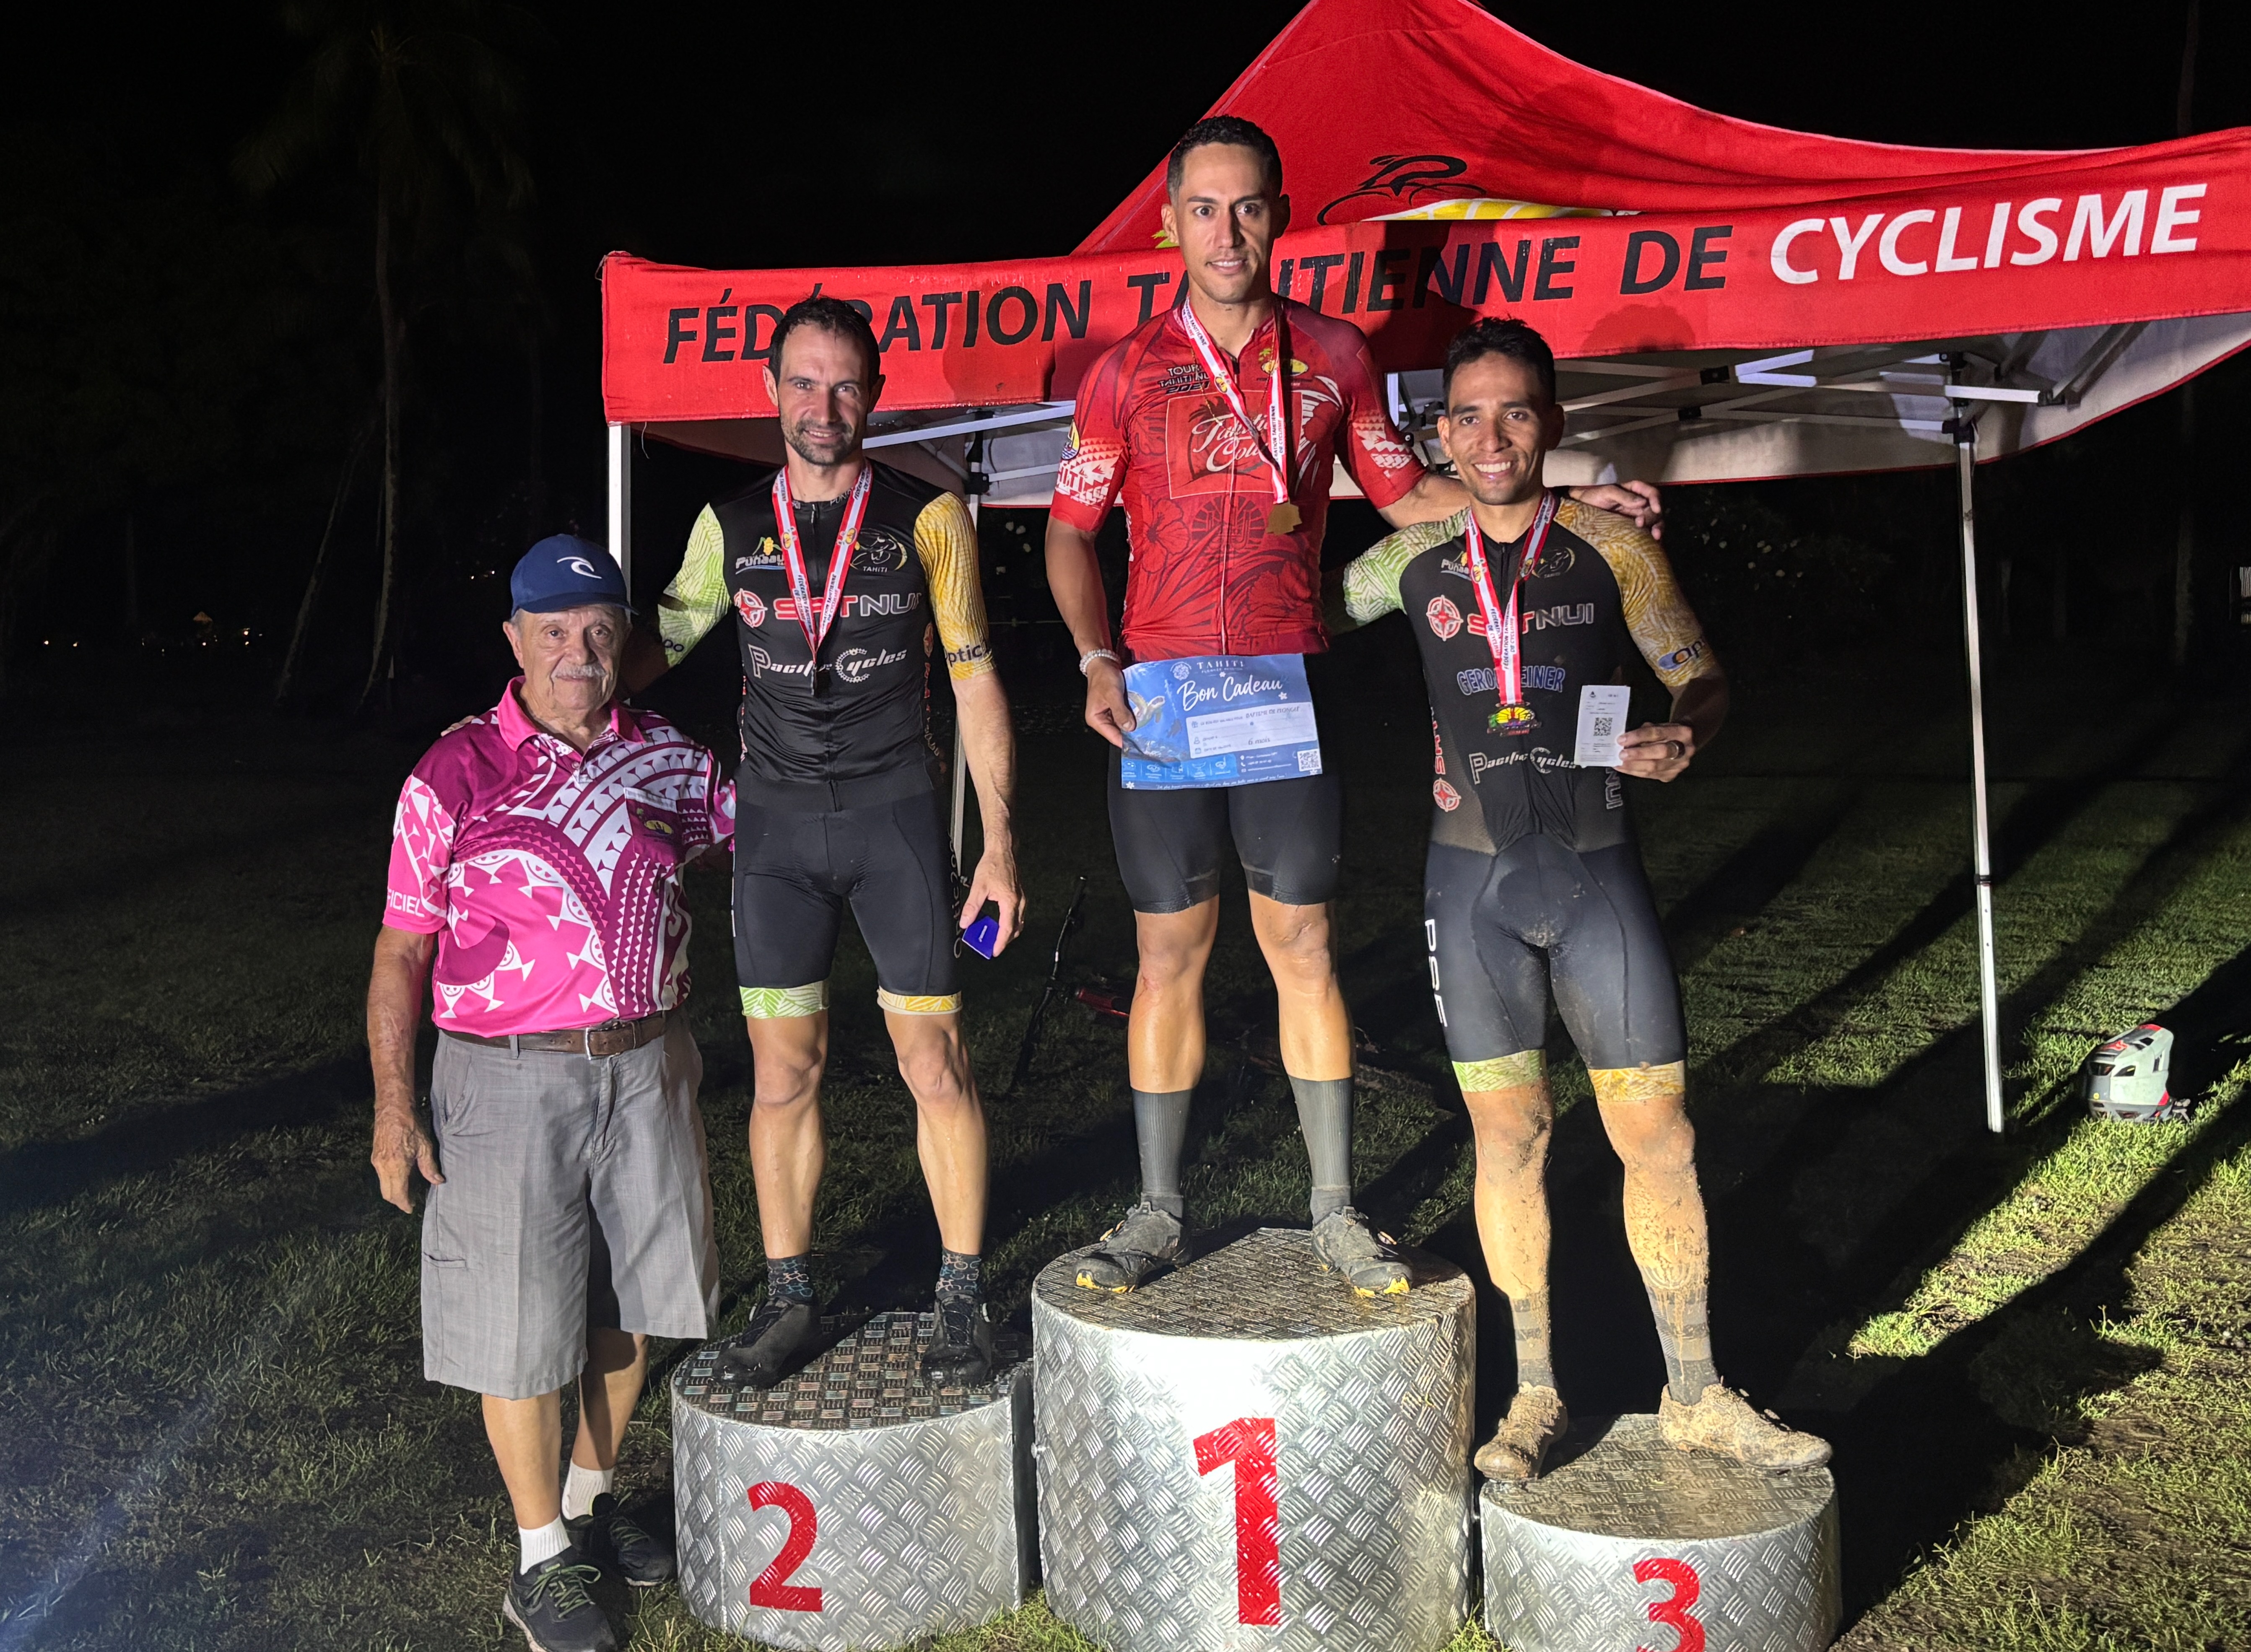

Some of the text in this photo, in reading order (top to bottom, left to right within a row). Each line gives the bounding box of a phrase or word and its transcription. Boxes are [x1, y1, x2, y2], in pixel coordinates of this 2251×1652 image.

[663, 183, 2207, 364] FÉDATION TITIENNE DE CYCLISME
[835, 648, 907, 683] Cycles
[1176, 674, 1283, 711] Bon Cadeau
[1197, 660, 1244, 670] TAHITI
[1457, 665, 1566, 696] GEROEINER
[747, 1482, 823, 1612] 2
[1193, 1417, 1281, 1626] 1
[1633, 1558, 1706, 1652] 3
